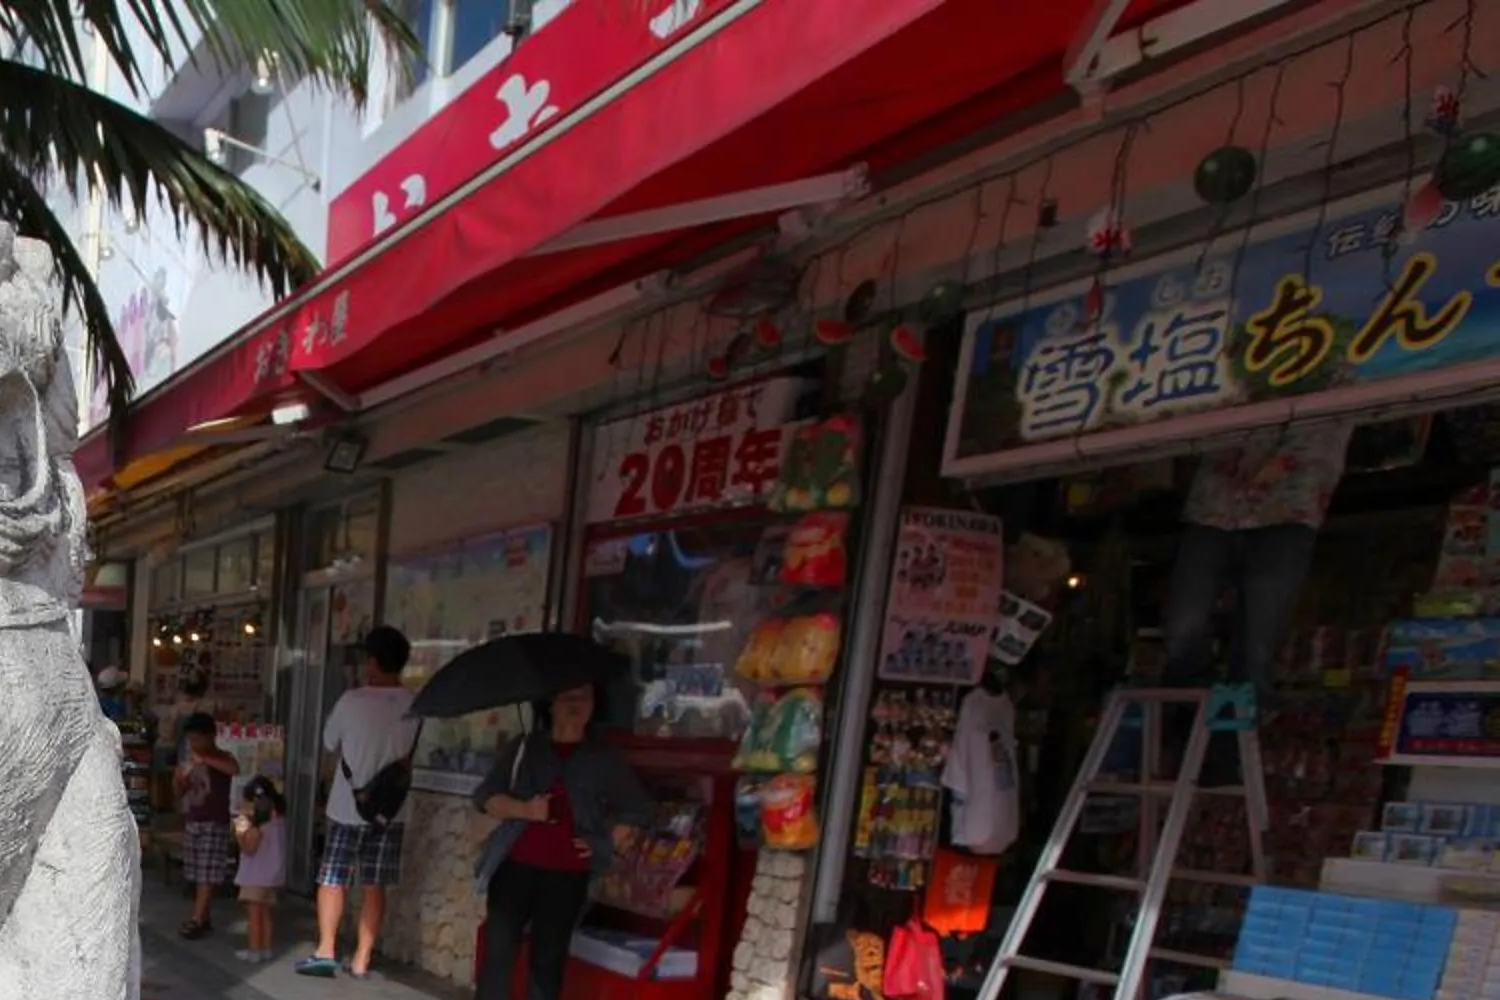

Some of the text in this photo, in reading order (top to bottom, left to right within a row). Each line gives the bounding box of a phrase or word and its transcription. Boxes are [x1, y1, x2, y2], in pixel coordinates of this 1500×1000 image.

[1020, 252, 1500, 440] 雪塩ちん
[614, 428, 782, 518] 20周年
